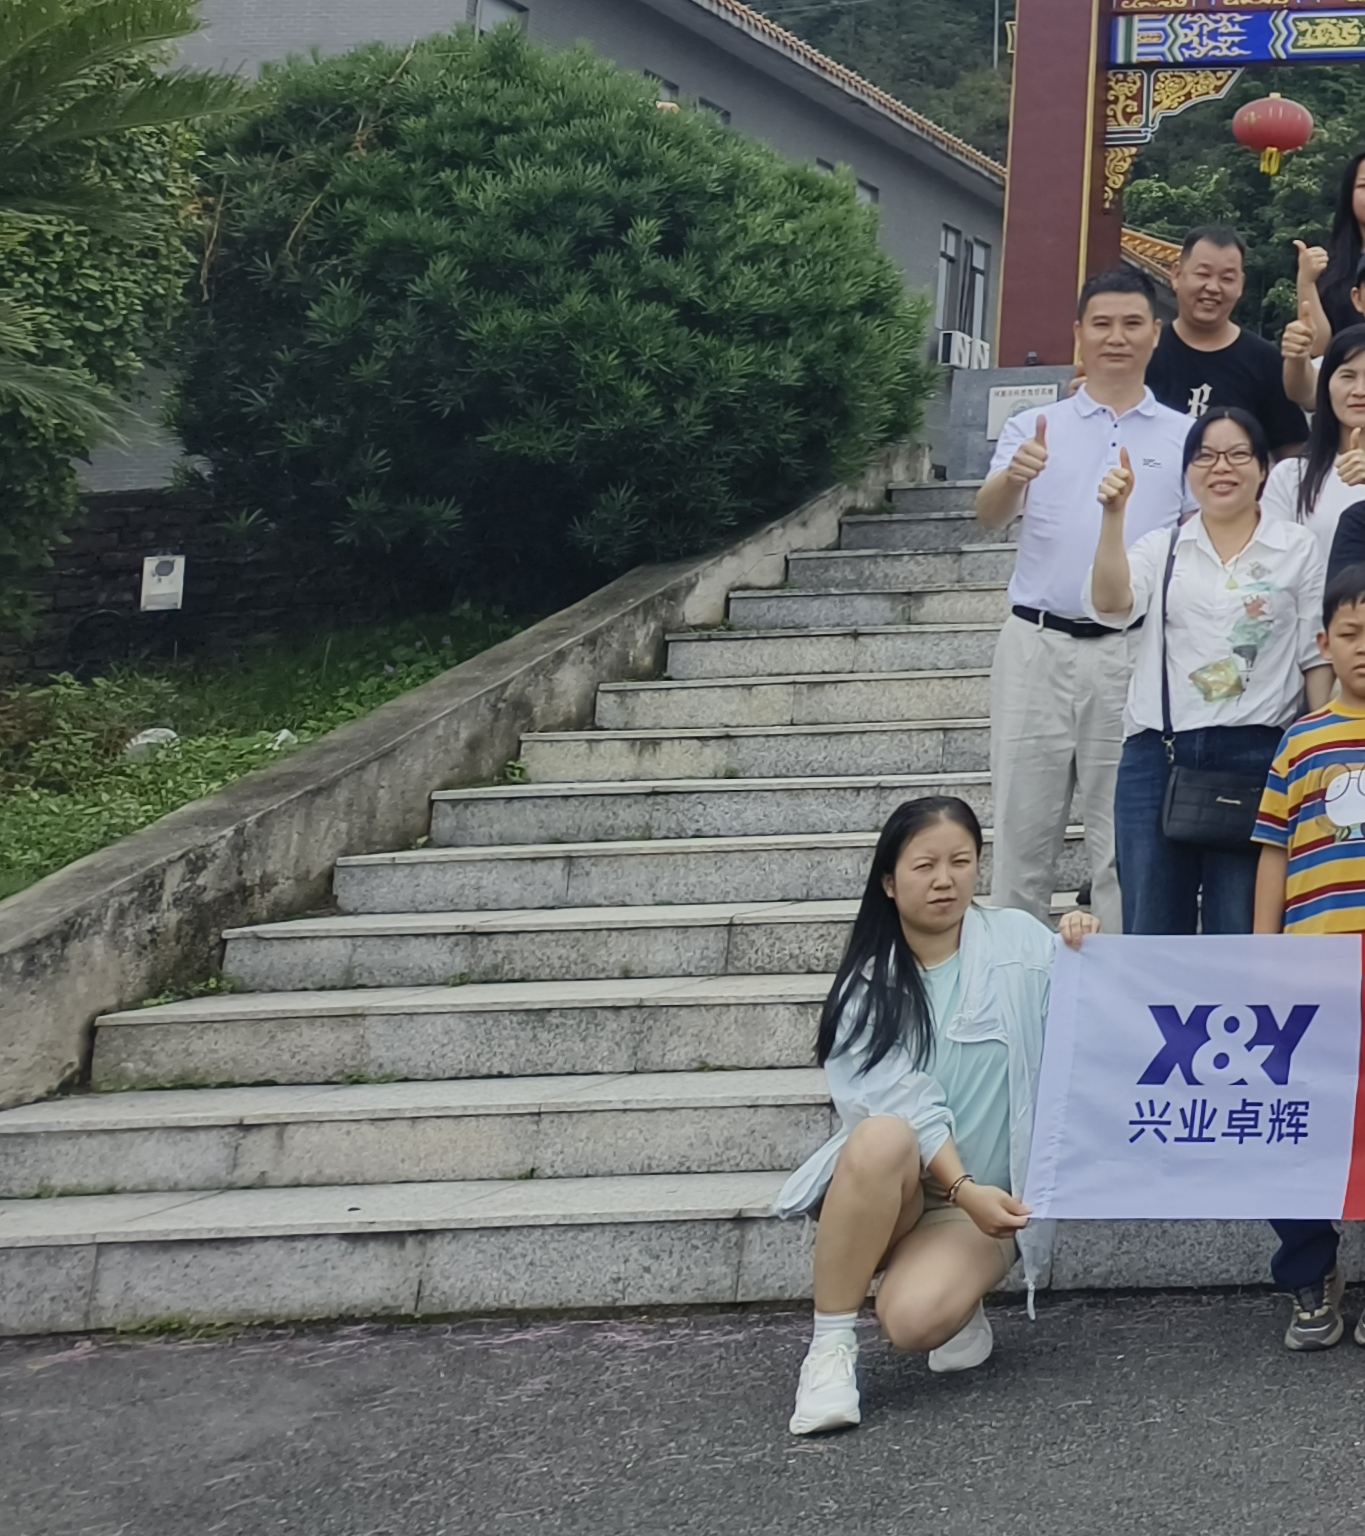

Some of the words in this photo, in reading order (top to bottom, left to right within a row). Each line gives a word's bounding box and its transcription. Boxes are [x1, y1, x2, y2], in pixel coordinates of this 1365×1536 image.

[1137, 1004, 1320, 1086] X&Y
[1128, 1097, 1310, 1146] 兴业卓辉
